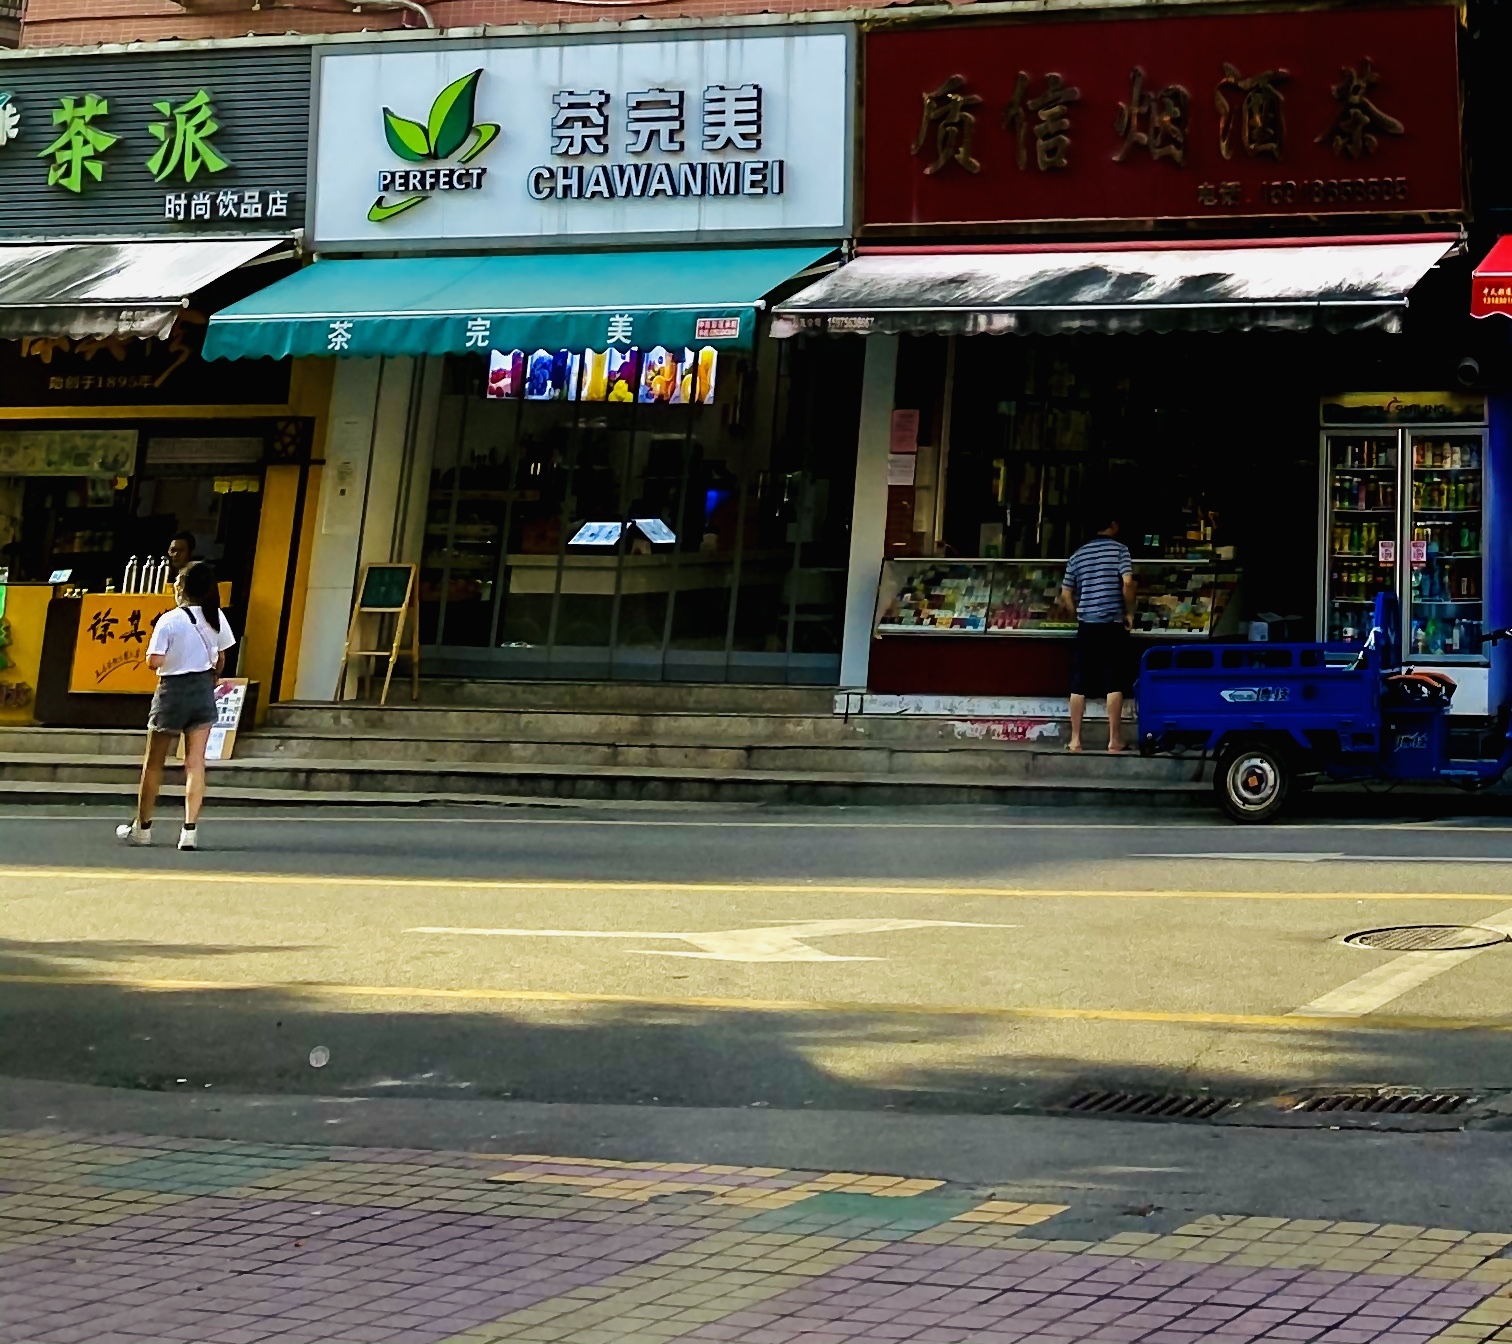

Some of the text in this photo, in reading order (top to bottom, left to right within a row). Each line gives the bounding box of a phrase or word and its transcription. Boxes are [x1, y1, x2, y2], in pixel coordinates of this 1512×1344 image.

[551, 83, 763, 156] 茶完美
[910, 55, 1405, 175] 质信烟酒茶
[37, 88, 231, 193] 茶派
[377, 166, 487, 193] PERFECT
[526, 158, 784, 203] CHAWANMEI
[164, 190, 289, 220] 时尚饮品店
[86, 607, 170, 645] 徐其
